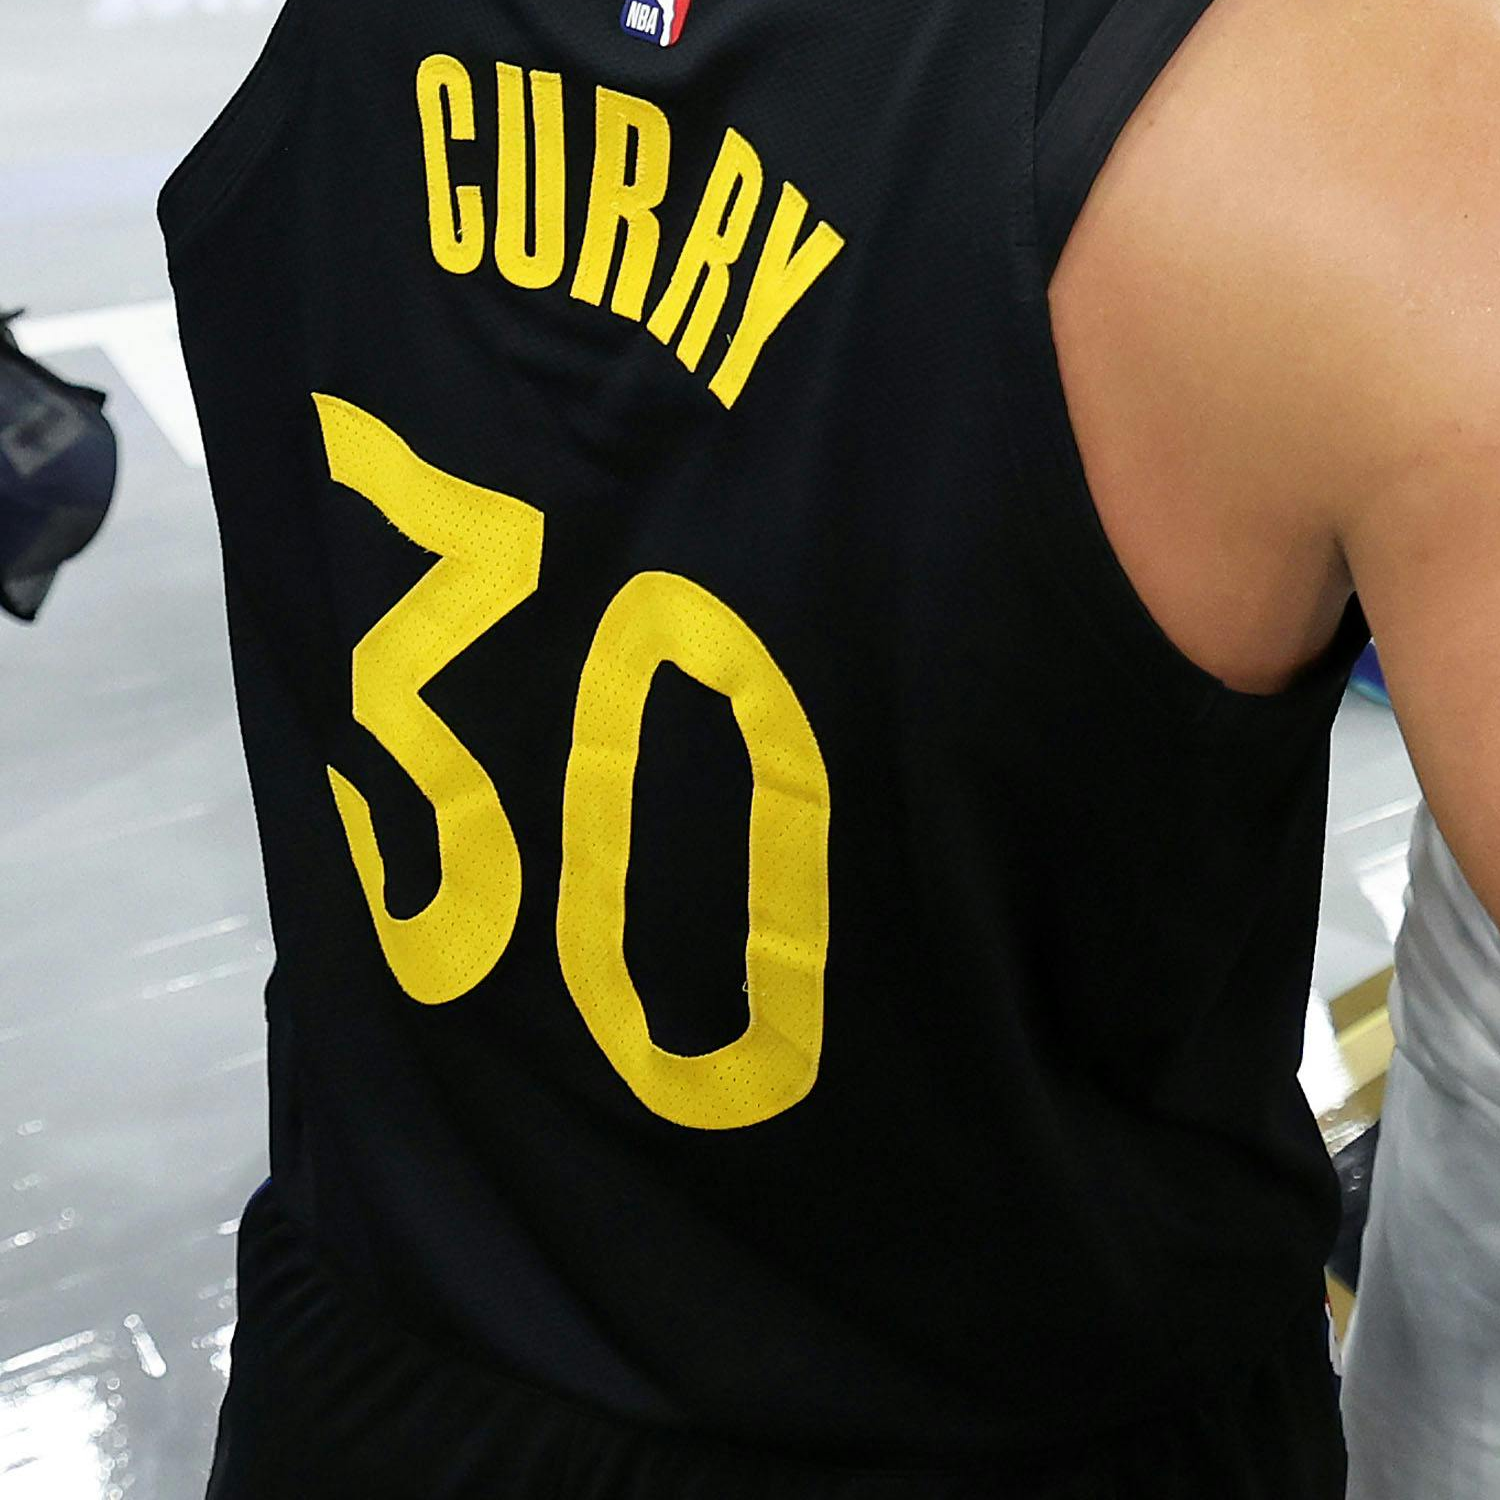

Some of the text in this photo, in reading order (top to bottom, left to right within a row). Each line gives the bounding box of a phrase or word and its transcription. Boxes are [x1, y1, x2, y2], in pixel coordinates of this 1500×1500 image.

[625, 0, 660, 35] NBA
[415, 53, 845, 409] CURRY
[312, 391, 832, 1131] 30
